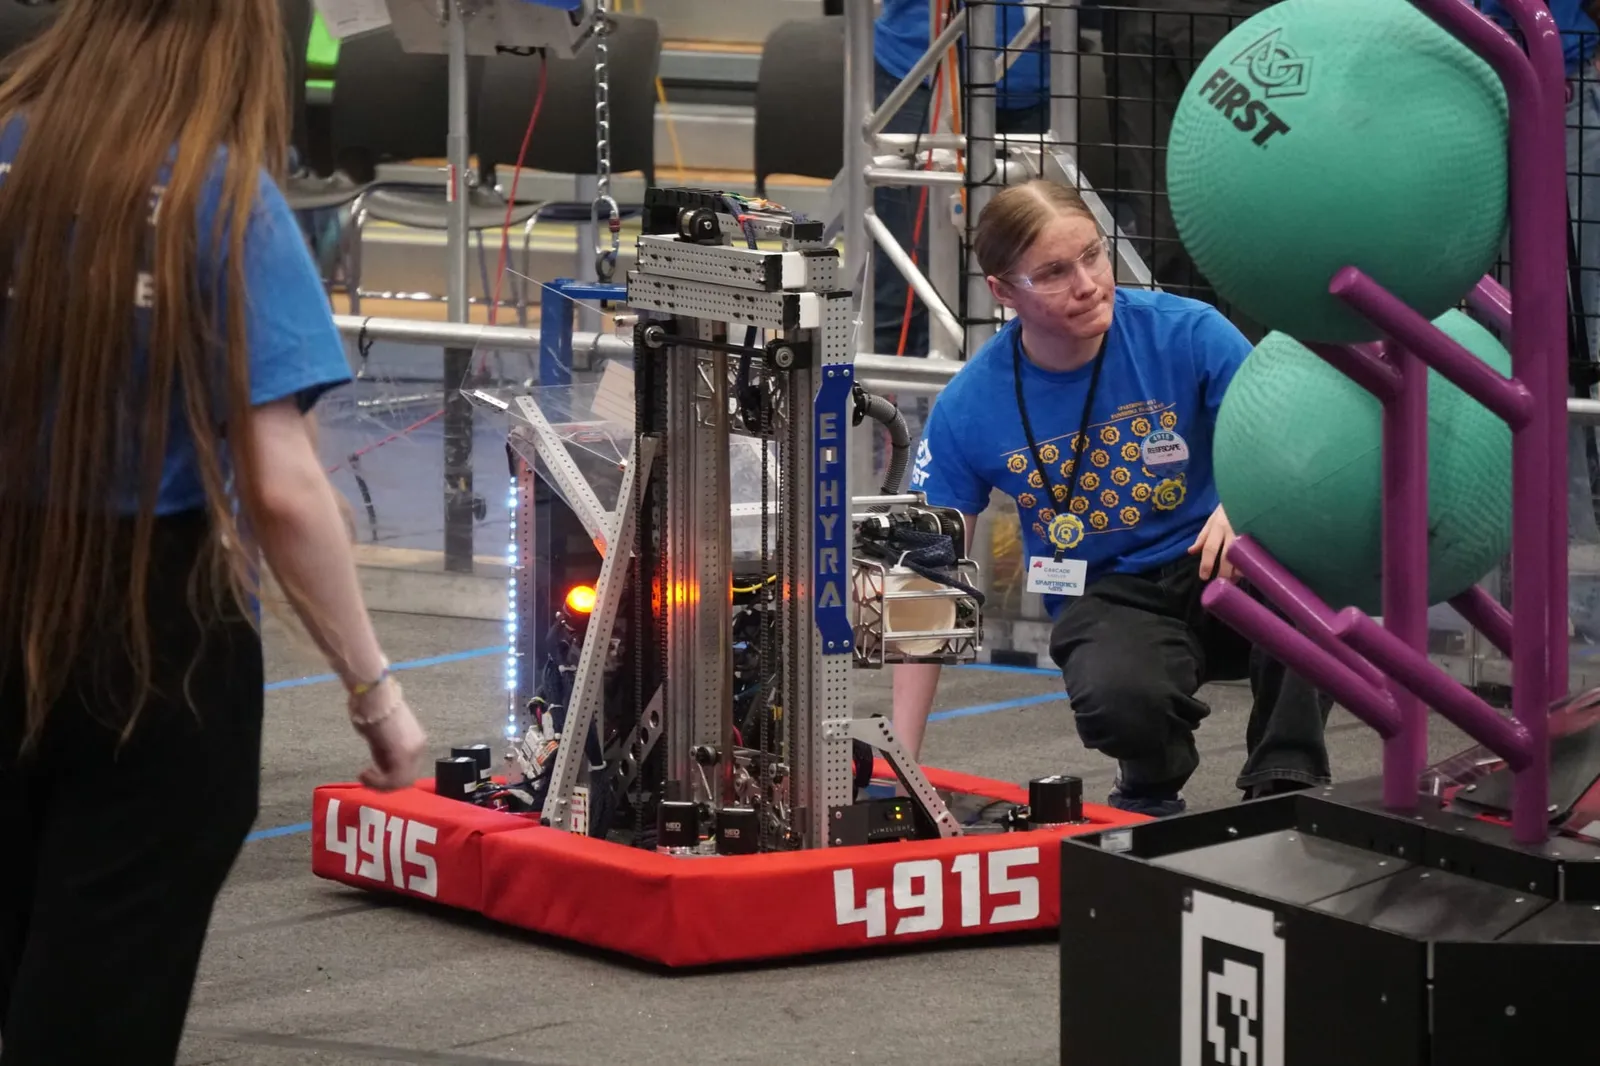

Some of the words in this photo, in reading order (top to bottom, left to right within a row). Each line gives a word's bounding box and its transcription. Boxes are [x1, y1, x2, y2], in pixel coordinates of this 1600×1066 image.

[1198, 67, 1291, 148] FIRST
[818, 412, 842, 608] EPHYRA
[326, 798, 438, 898] 4915
[833, 846, 1040, 938] 4915
